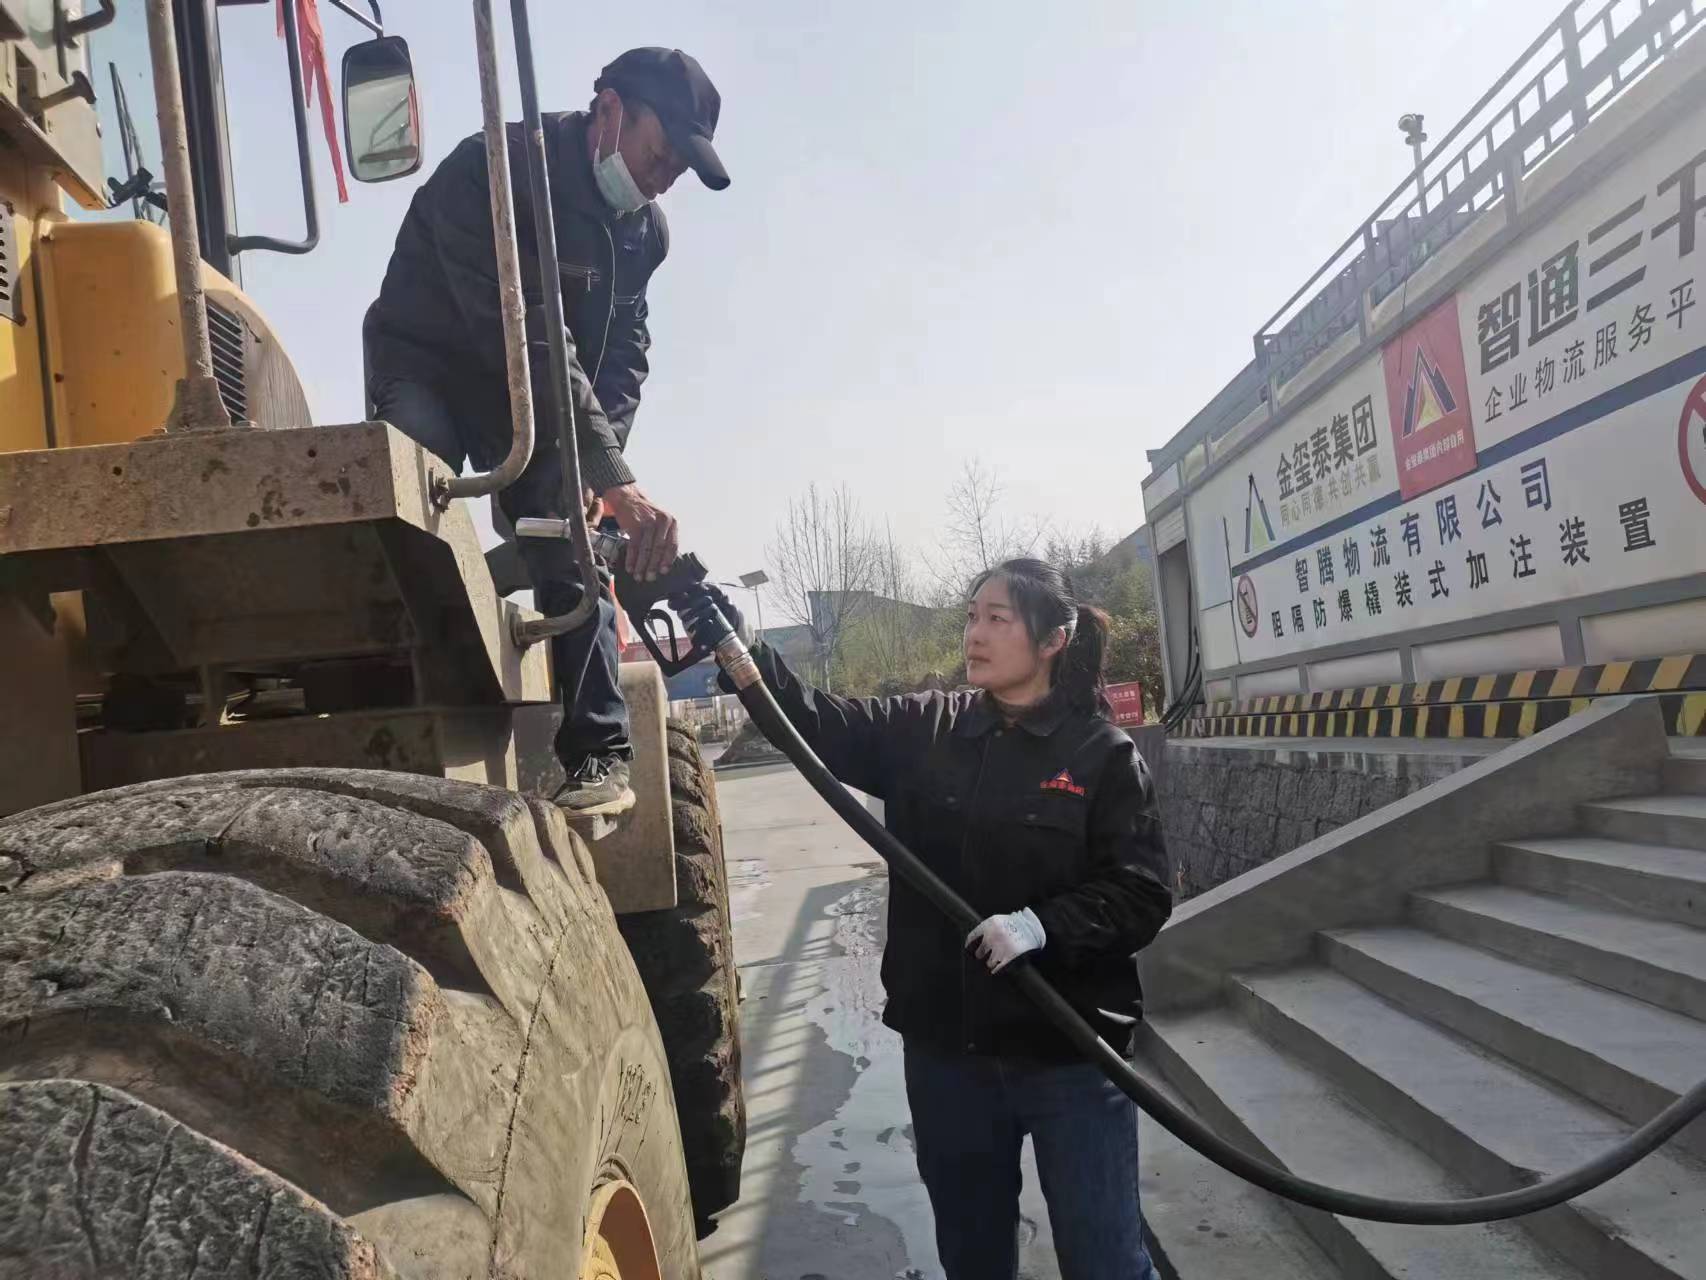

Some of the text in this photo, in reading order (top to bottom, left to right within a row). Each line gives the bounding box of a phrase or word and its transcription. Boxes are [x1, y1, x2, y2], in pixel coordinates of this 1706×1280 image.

[1484, 278, 1696, 424] 企业物流服务平
[1276, 394, 1378, 501] 金玺泰集团
[1295, 457, 1552, 594] 智腾物流有限公司
